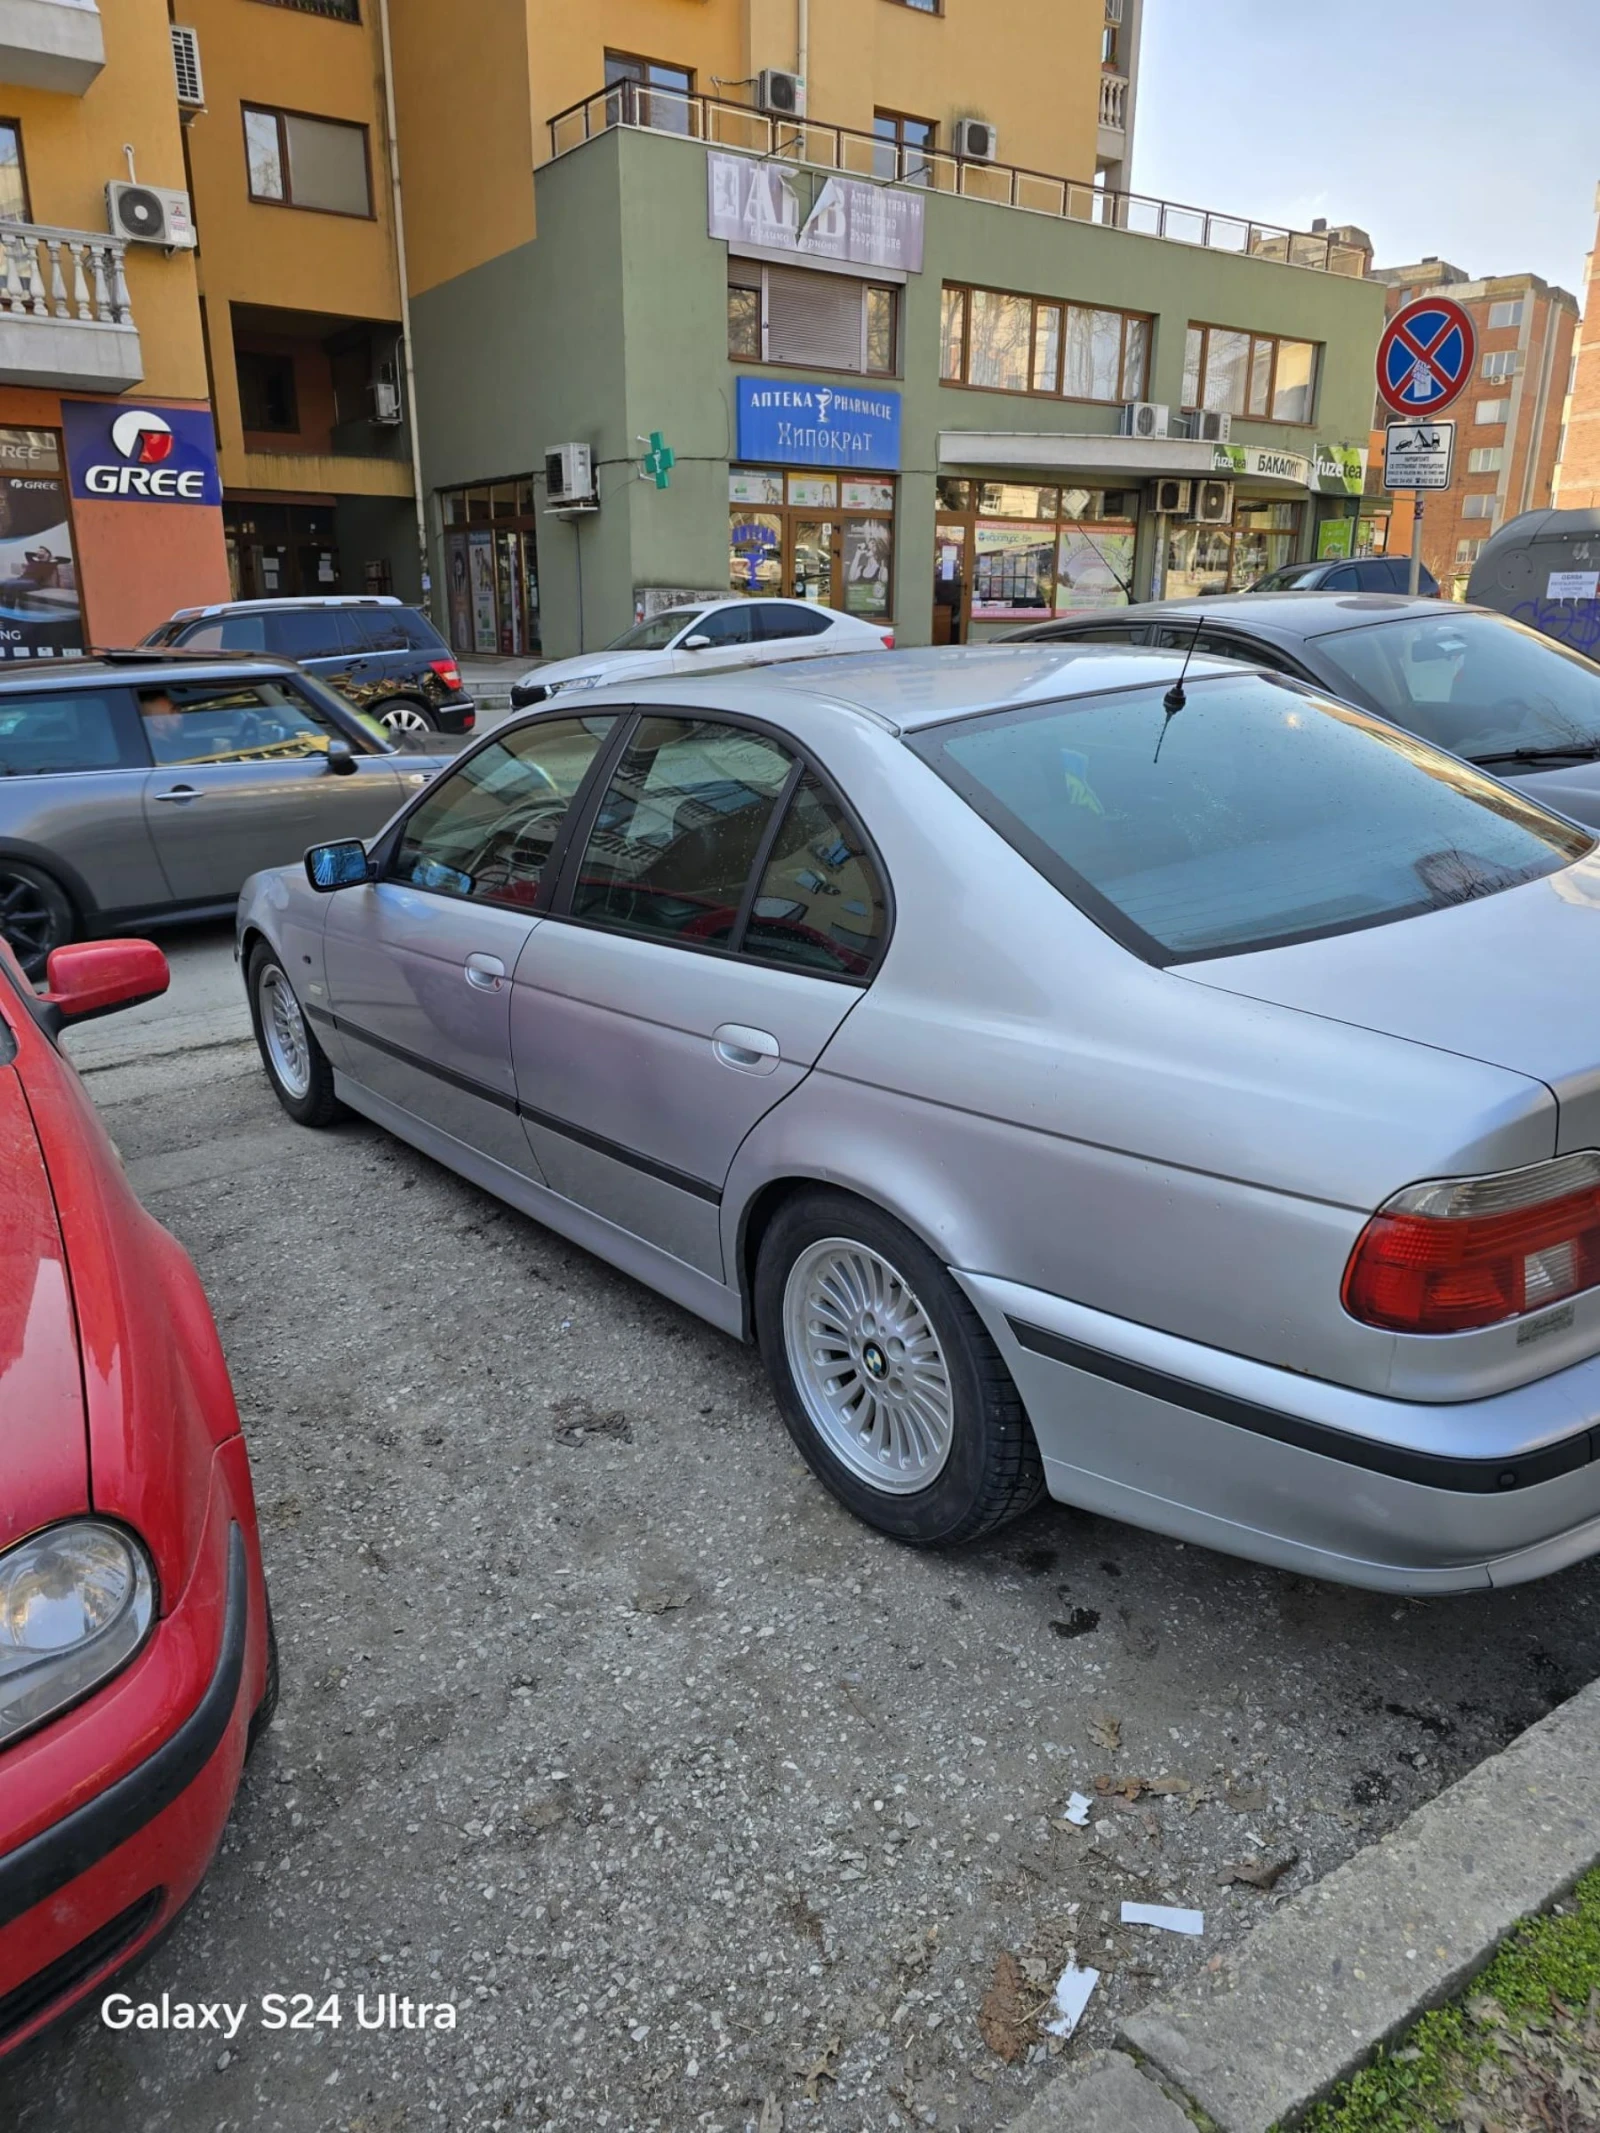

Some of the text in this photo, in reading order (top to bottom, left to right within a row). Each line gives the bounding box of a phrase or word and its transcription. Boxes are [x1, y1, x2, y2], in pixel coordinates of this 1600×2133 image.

[751, 391, 813, 408] АПТЕКА
[834, 394, 892, 421] PHARMACIE
[0, 443, 41, 460] REE
[24, 481, 58, 491] GREE
[85, 465, 205, 498] GREE
